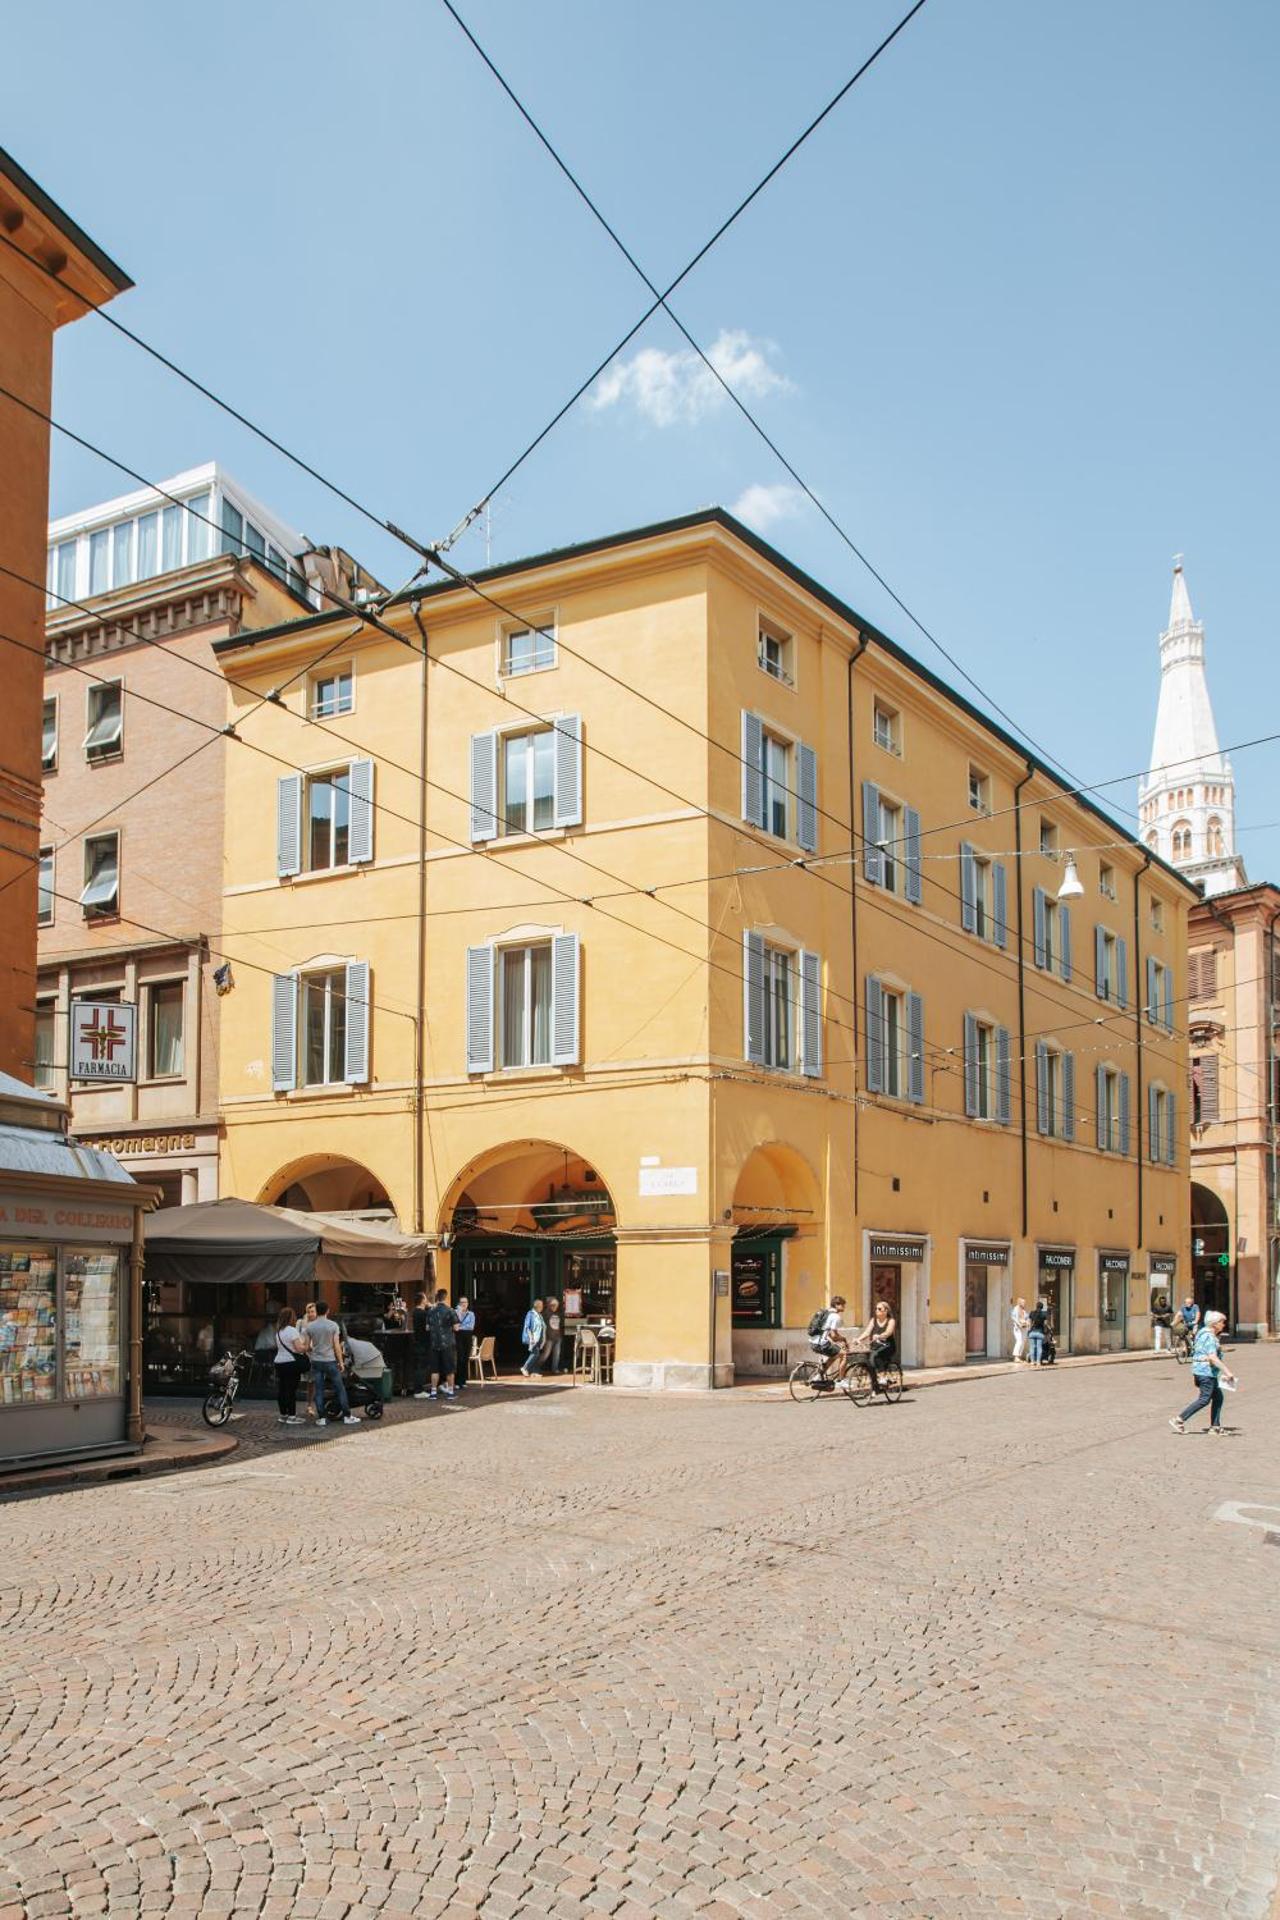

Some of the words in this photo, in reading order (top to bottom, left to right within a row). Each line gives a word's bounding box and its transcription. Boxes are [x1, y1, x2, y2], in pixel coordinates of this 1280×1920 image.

[78, 1061, 127, 1075] FARMACIA
[98, 1134, 196, 1154] Romagna
[873, 1244, 923, 1257] intimissimi
[968, 1250, 1007, 1261] intimissimi
